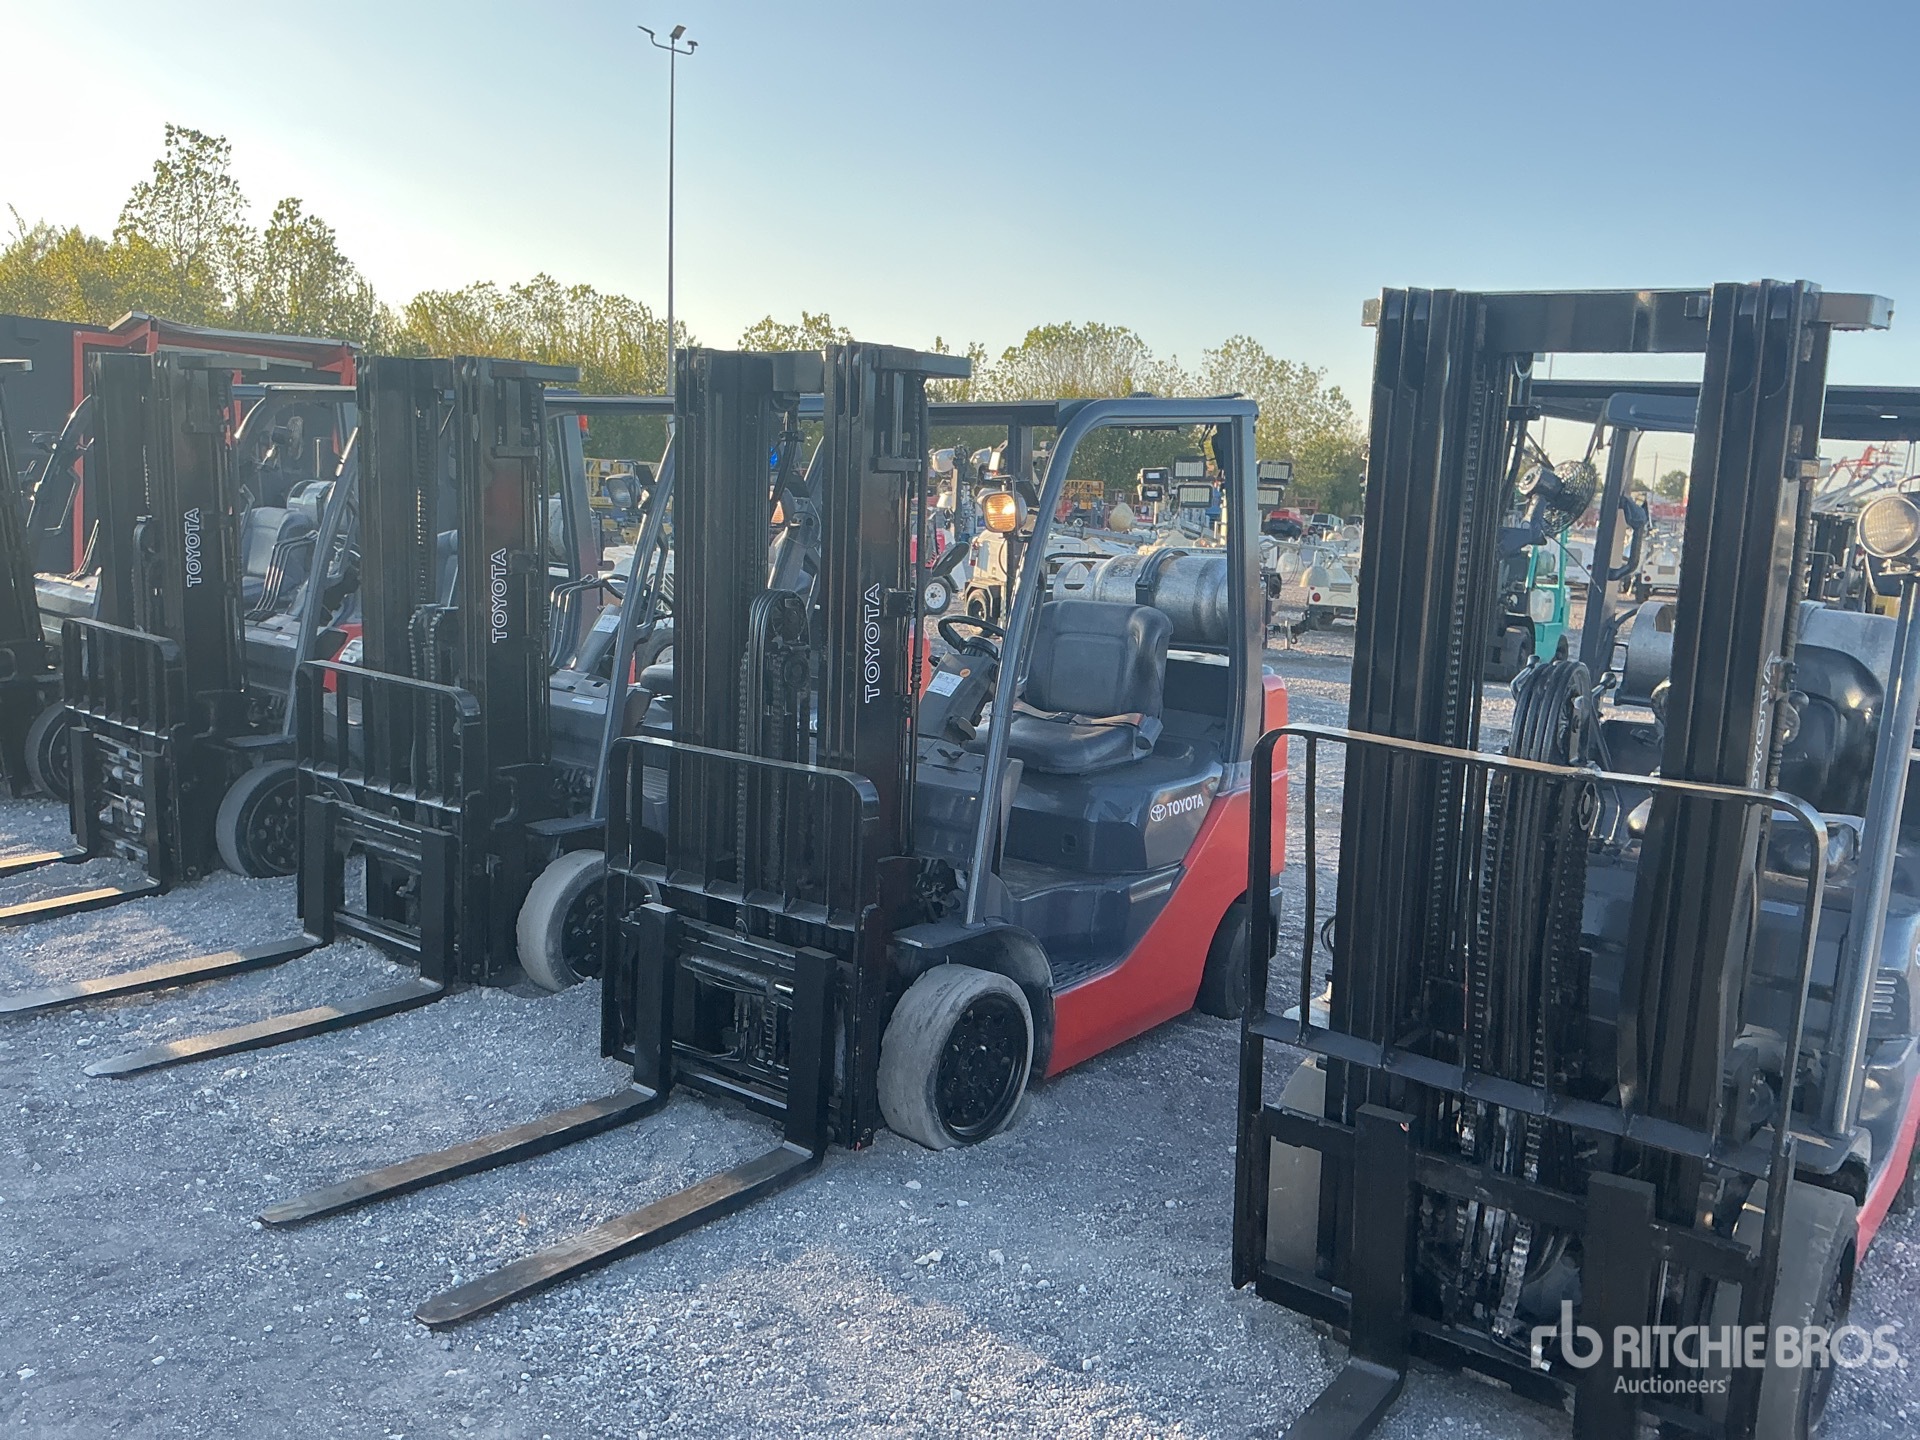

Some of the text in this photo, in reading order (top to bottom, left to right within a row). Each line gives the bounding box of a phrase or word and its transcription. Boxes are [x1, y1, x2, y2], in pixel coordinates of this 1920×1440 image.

[184, 507, 202, 588] TOYOTA
[490, 547, 508, 644] TOYOTA
[864, 582, 880, 703] TOYOTA
[1166, 793, 1204, 817] TOYOTA
